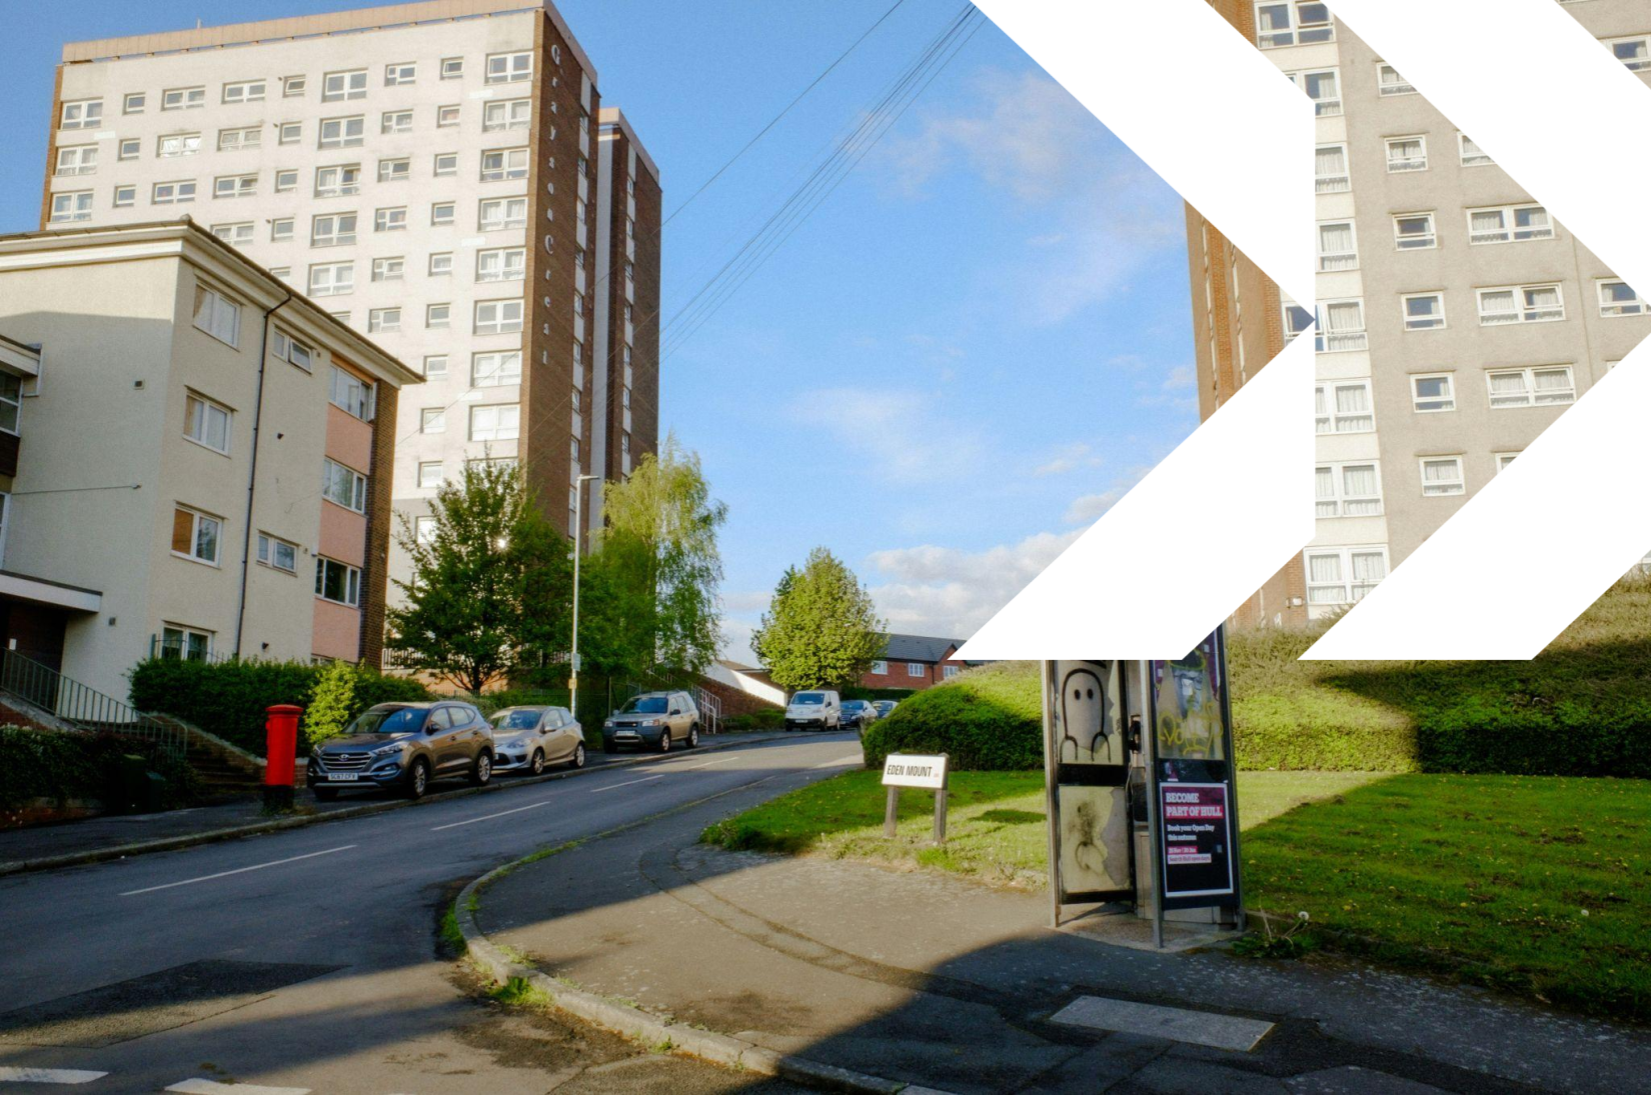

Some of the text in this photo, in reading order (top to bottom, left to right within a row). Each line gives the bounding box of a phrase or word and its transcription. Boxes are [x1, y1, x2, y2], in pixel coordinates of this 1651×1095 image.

[886, 764, 932, 777] EDEN MOUNT
[1165, 792, 1200, 803] BECOME
[1165, 806, 1223, 817] PART OF HULL
[1192, 824, 1205, 832] Open
[1205, 824, 1215, 832] Day
